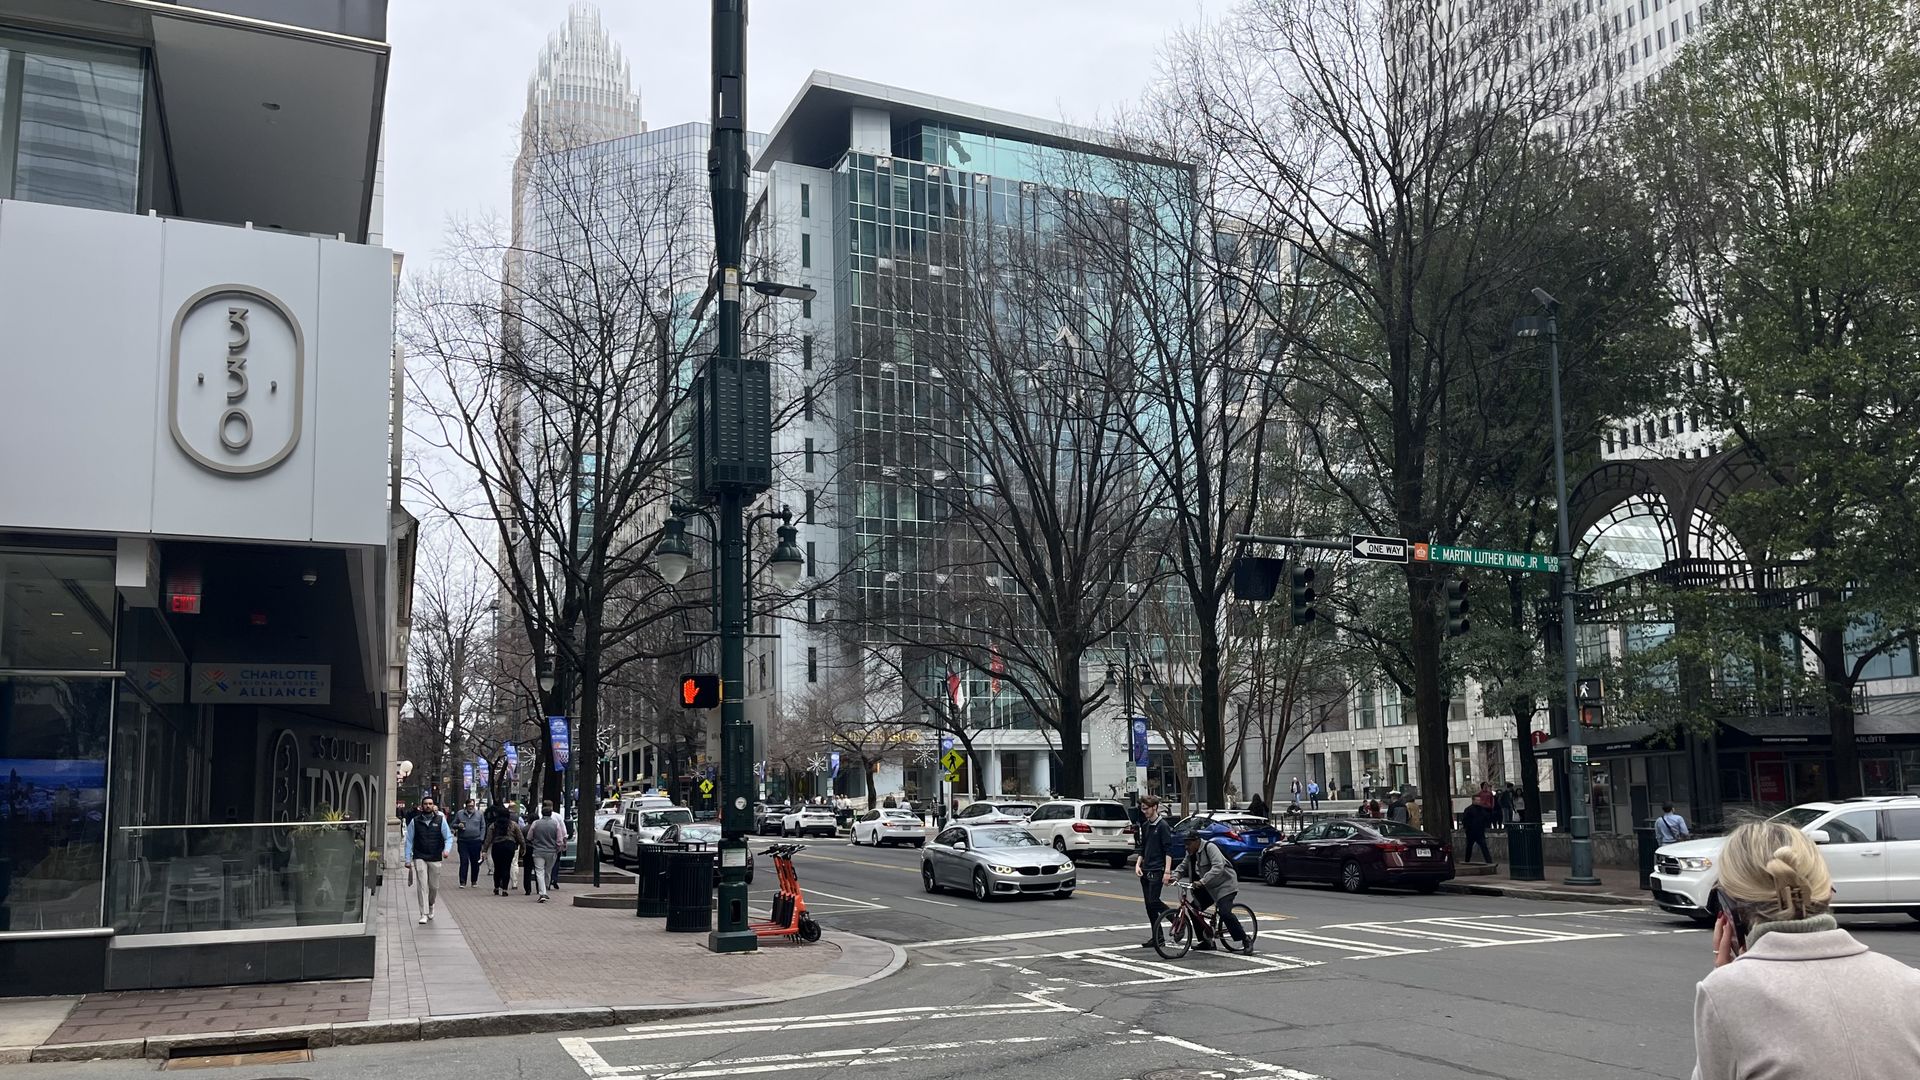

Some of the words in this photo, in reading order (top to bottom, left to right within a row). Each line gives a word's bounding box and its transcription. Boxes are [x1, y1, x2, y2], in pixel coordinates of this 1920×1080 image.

[219, 307, 253, 450] 330
[1368, 544, 1384, 553] ONE
[1385, 545, 1401, 555] WAY
[1431, 547, 1439, 560] E.
[1442, 548, 1472, 563] MARTIN
[1474, 551, 1504, 565] LUTHER
[1507, 554, 1525, 568] KING
[1527, 556, 1538, 569] JR
[1543, 556, 1558, 565] BLVD
[1548, 564, 1558, 573] 100
[240, 670, 318, 680] CHARLOTTE
[239, 687, 317, 697] ALLIANCE
[319, 735, 372, 765] SOUTH
